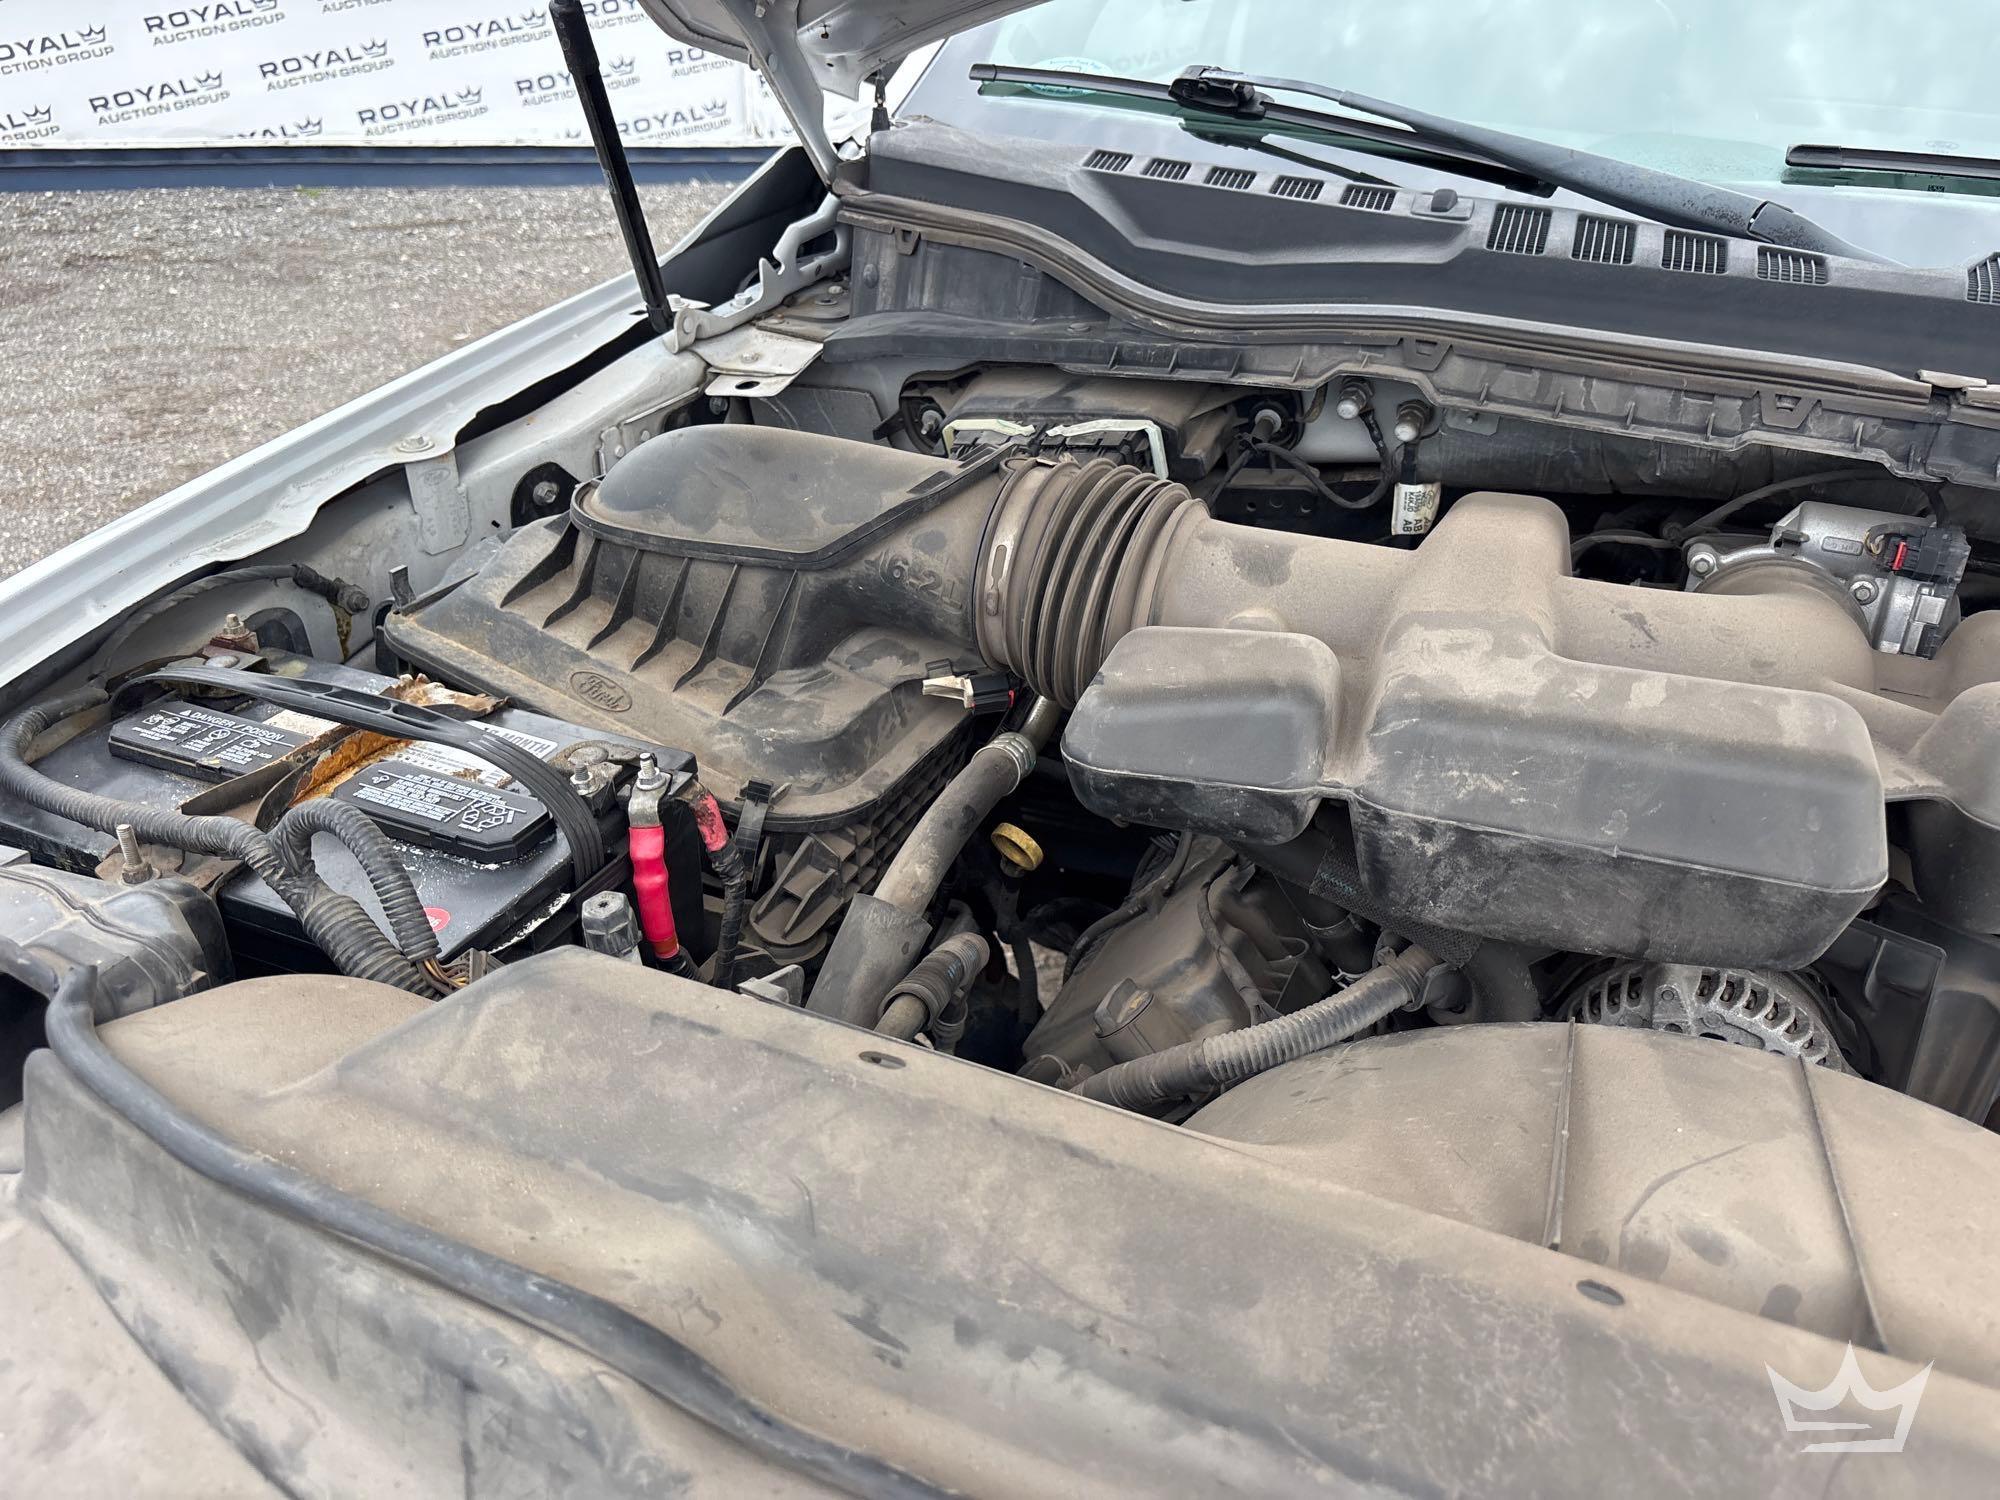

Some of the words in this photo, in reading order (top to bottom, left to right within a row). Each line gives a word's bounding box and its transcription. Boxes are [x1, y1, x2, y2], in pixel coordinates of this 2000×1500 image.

[143, 0, 252, 33] ROYAL
[153, 23, 227, 47] AUCTION
[228, 12, 286, 32] GROUP
[423, 17, 522, 48] ROYAL
[0, 33, 80, 61] OYAL
[0, 57, 53, 75] CTION
[55, 46, 115, 65] GROUP
[429, 38, 498, 61] AUCTION
[499, 30, 554, 48] GROUP
[259, 46, 363, 79] ROYAL
[266, 69, 337, 92] AUCTION
[339, 58, 395, 78] GROUP
[88, 80, 199, 114] ROYAL
[98, 101, 171, 126] AUCTION
[173, 90, 231, 111] GROUP
[357, 93, 459, 126] ROYAL
[365, 114, 435, 137] AUCTION
[435, 104, 489, 125] GROUP
[1402, 519, 1412, 532] AB
[579, 674, 625, 709] Ford
[190, 711, 236, 729] DANGER
[241, 725, 285, 741] POISON
